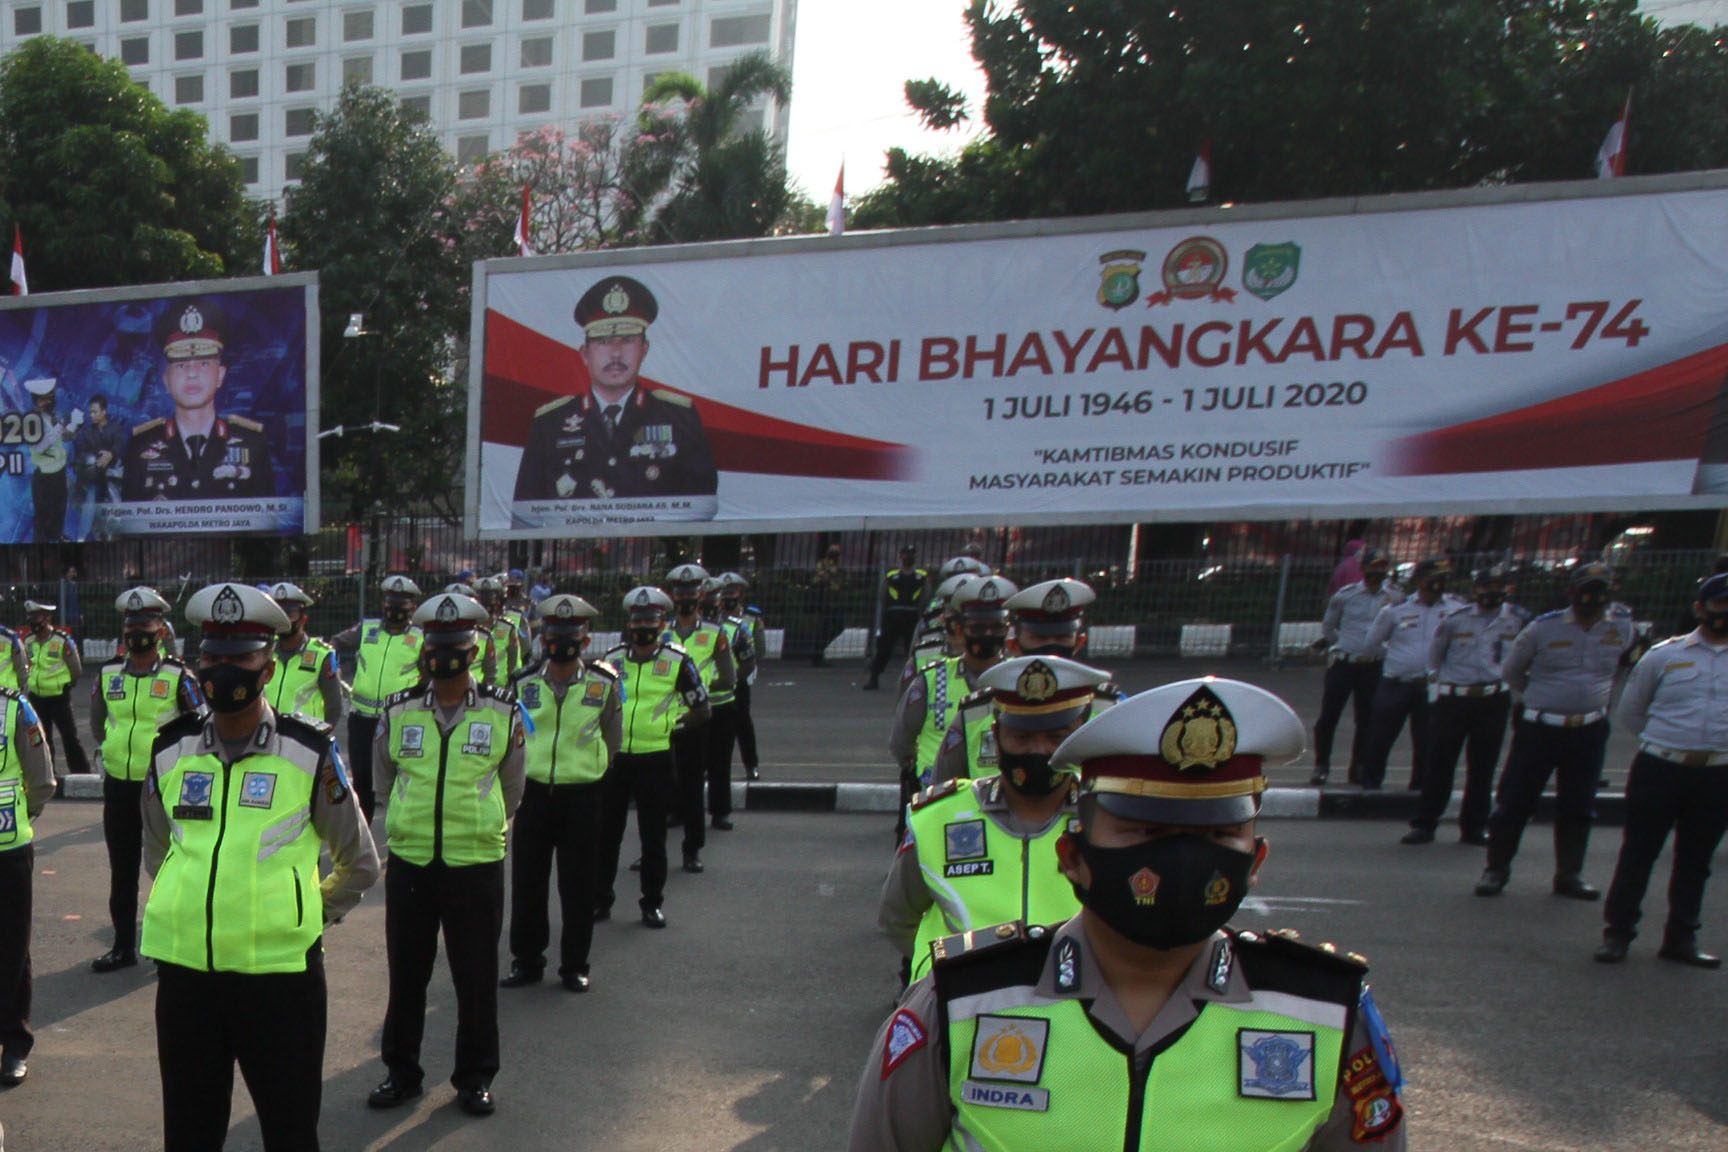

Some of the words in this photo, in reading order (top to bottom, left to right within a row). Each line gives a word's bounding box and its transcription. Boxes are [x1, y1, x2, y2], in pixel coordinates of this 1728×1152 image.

[758, 339, 902, 388] HARI
[918, 311, 1425, 381] BHAYANGKARA
[1443, 299, 1651, 356] KE-74
[983, 398, 994, 420] 1
[1001, 394, 1071, 420] JULI
[1079, 389, 1153, 416] 1946
[1183, 388, 1194, 412] 1
[1202, 385, 1274, 411] JULI
[1284, 381, 1367, 408] 2020
[1034, 444, 1176, 465] "KAMTIBMAS
[1180, 439, 1299, 461] KONDUSIF
[8, 453, 23, 474] II
[969, 470, 1116, 490] MASYARAKAT
[1120, 466, 1221, 486] SEMAKIN
[175, 505, 213, 514] HENDRO
[148, 520, 200, 530] WAKAPOLDA
[201, 519, 230, 529] METRO
[232, 519, 251, 528] JAYA
[947, 862, 979, 877] ASEP
[980, 861, 991, 873] T.
[972, 1088, 1035, 1106] INDRA
